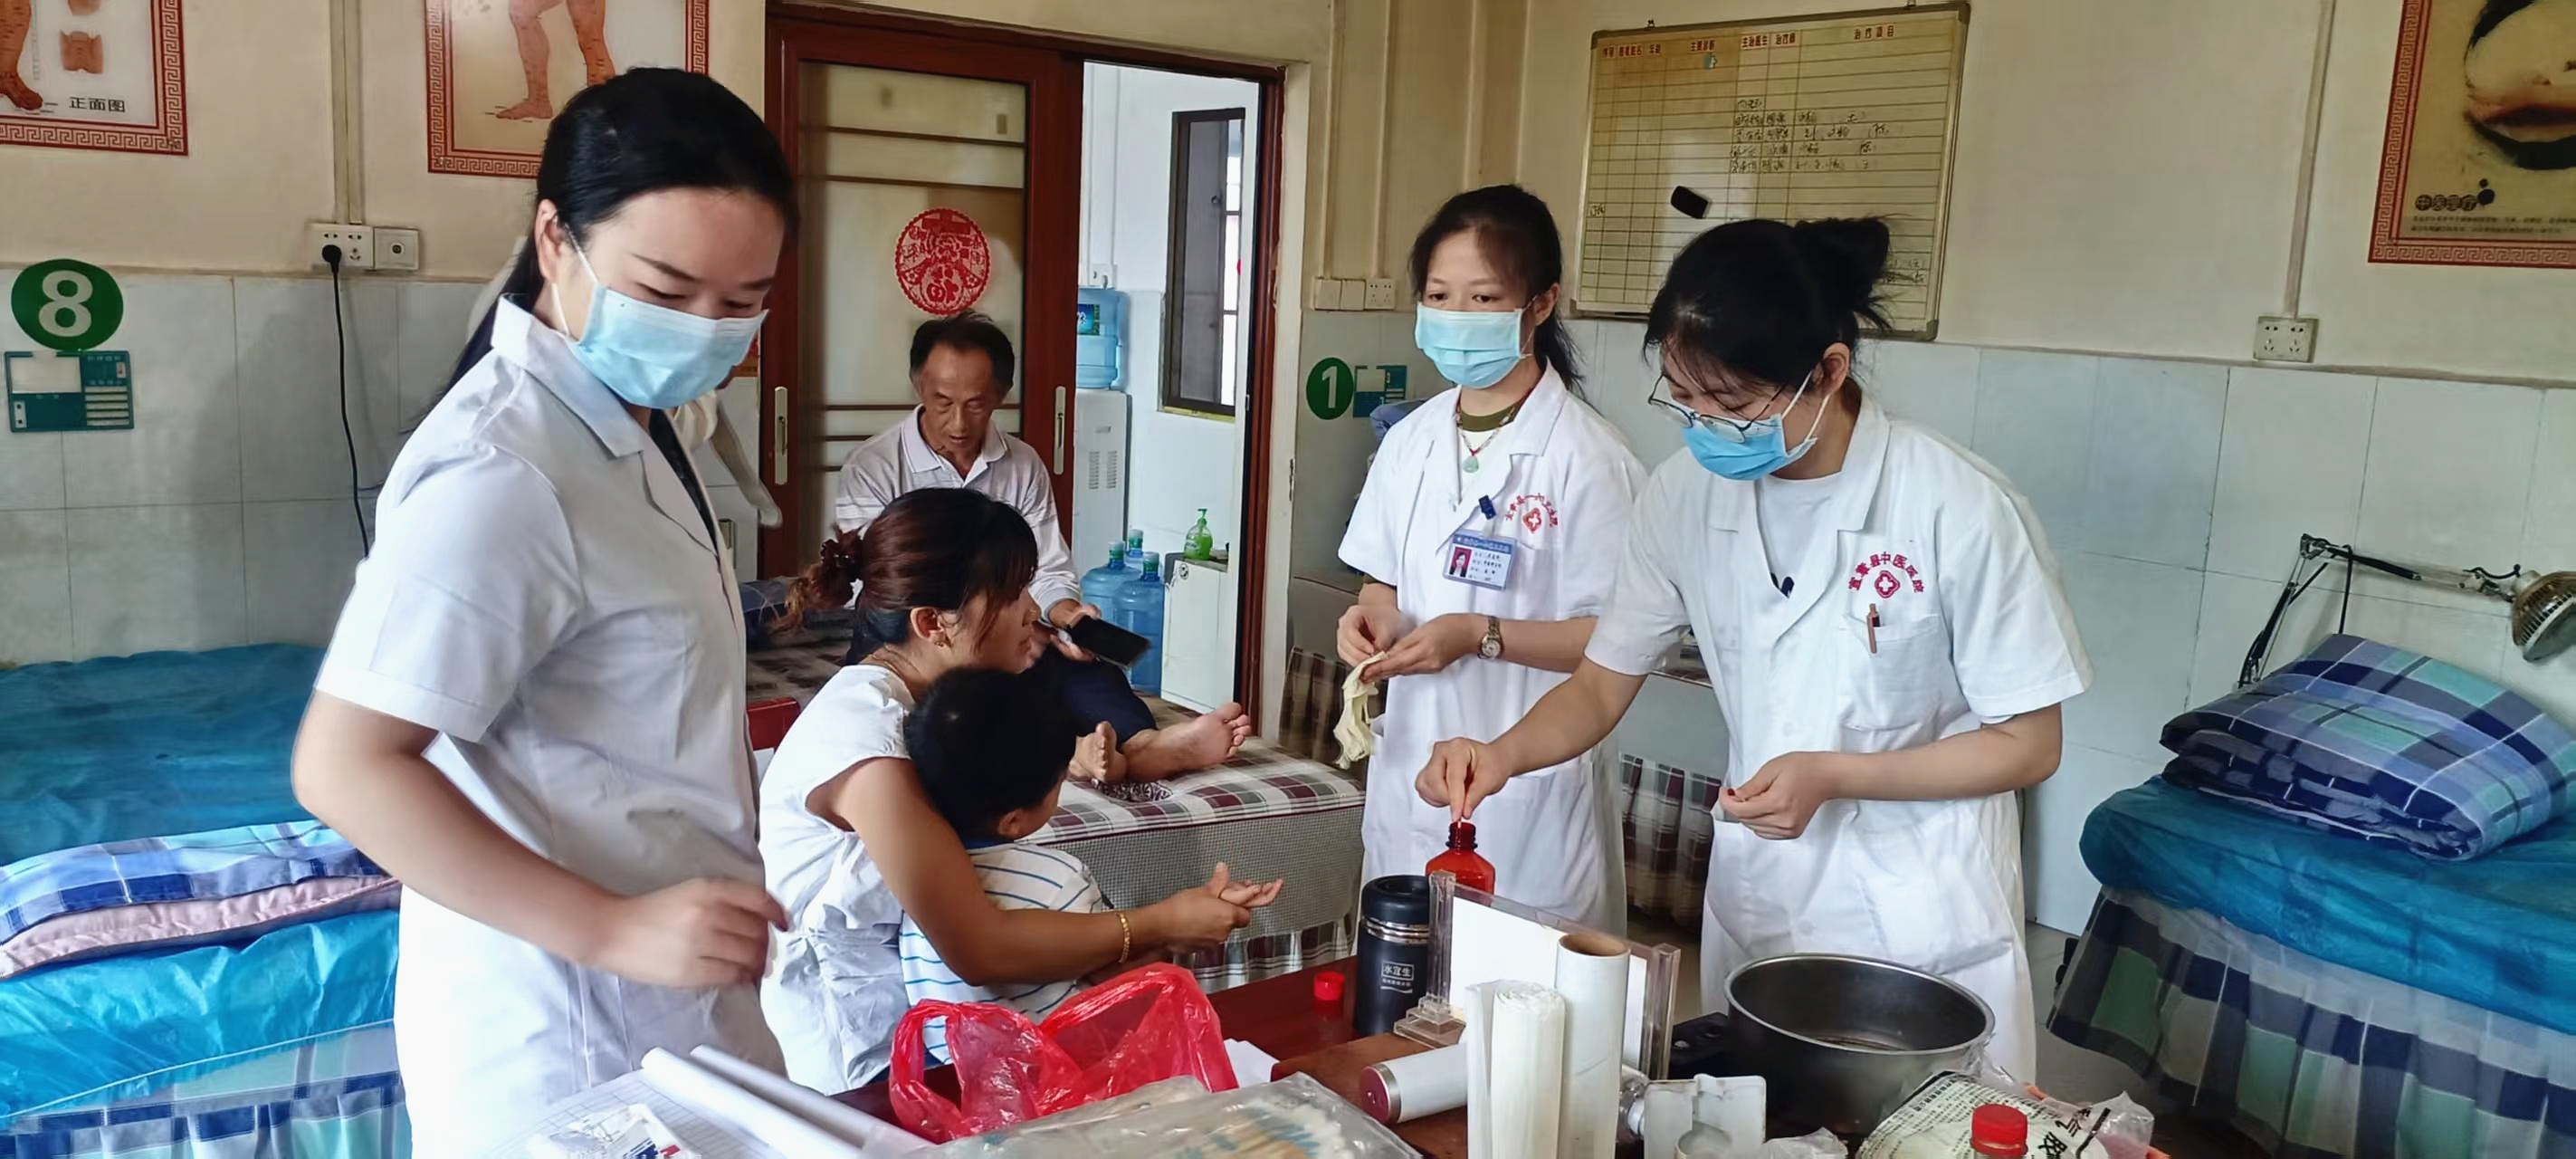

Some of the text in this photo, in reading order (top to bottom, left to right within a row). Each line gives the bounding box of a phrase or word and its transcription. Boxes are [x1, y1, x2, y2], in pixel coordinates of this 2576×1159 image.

[69, 96, 126, 113] 正面图
[38, 270, 93, 338] 8
[1321, 365, 1338, 409] 1
